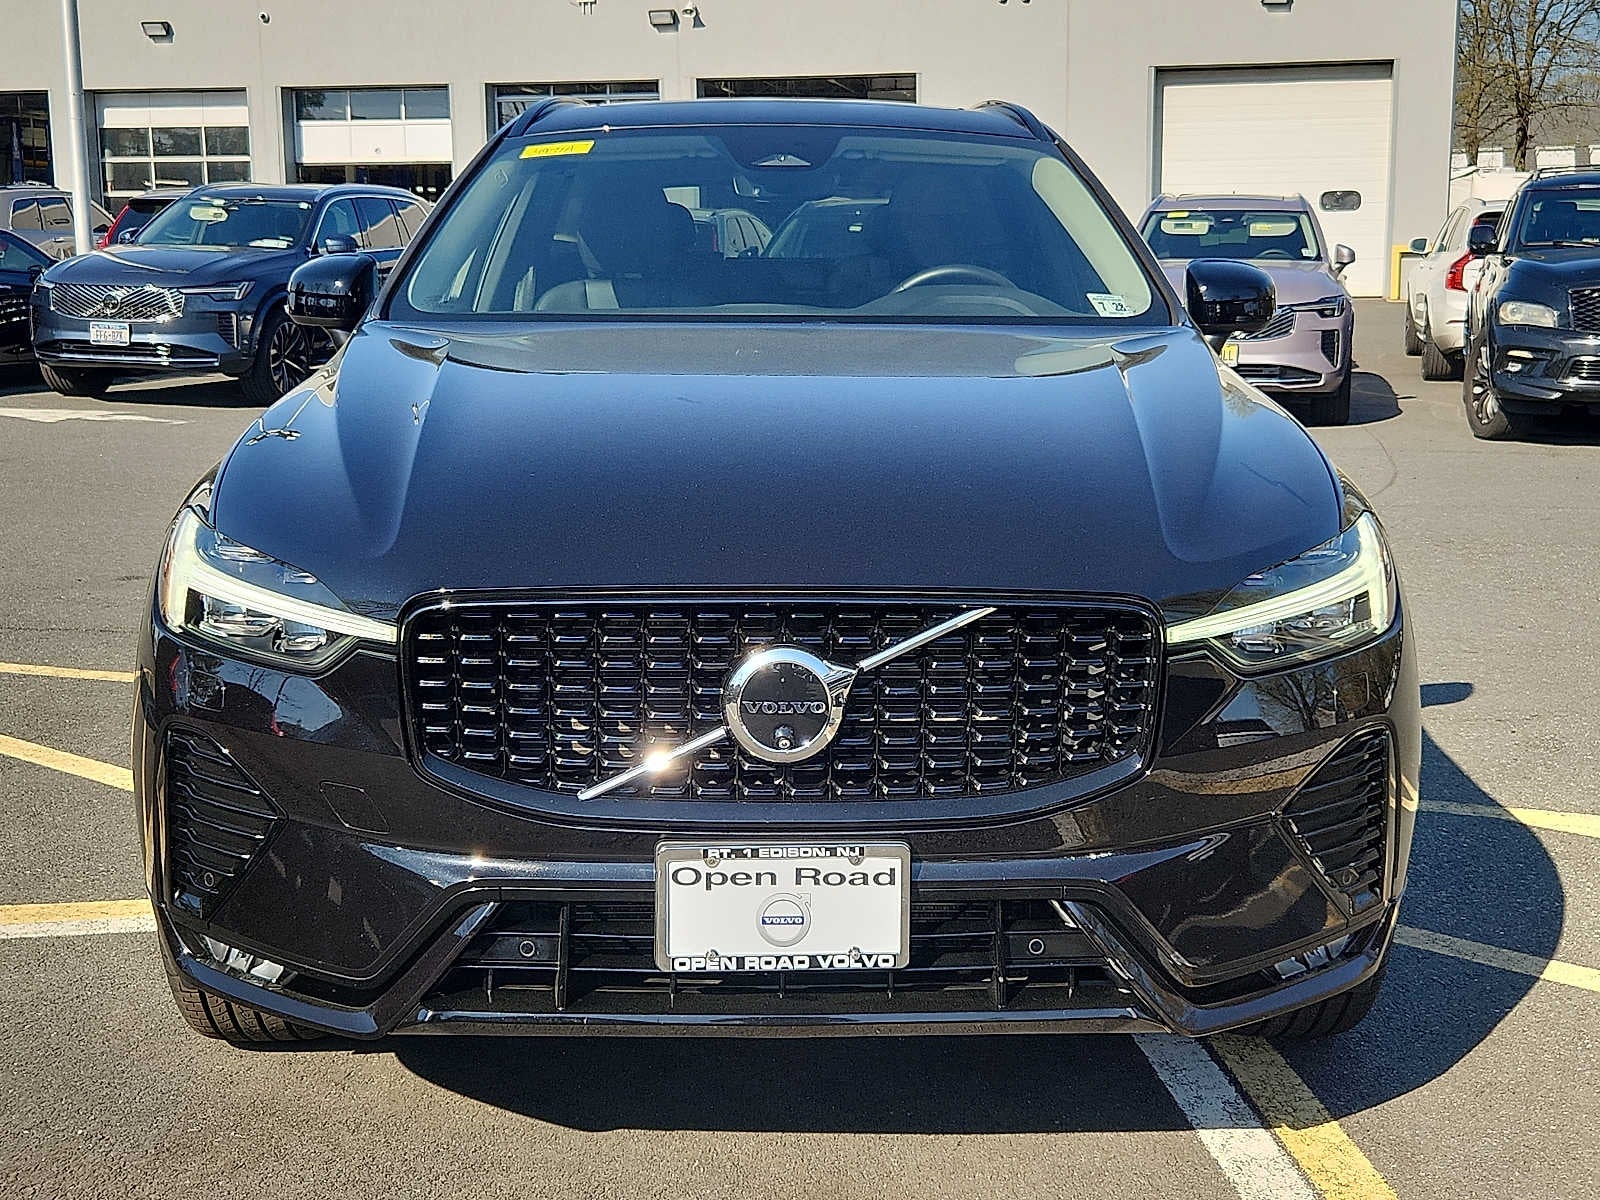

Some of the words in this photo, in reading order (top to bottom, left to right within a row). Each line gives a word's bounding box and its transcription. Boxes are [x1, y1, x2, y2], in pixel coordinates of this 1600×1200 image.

[742, 701, 826, 714] VOLVO
[707, 848, 736, 858] RT.
[742, 848, 752, 858] 1
[836, 846, 860, 857] NJ
[671, 867, 777, 890] Open
[795, 867, 896, 886] Road
[673, 956, 737, 971] OPEN
[744, 955, 810, 970] ROAD
[816, 954, 895, 969] VOLVO
